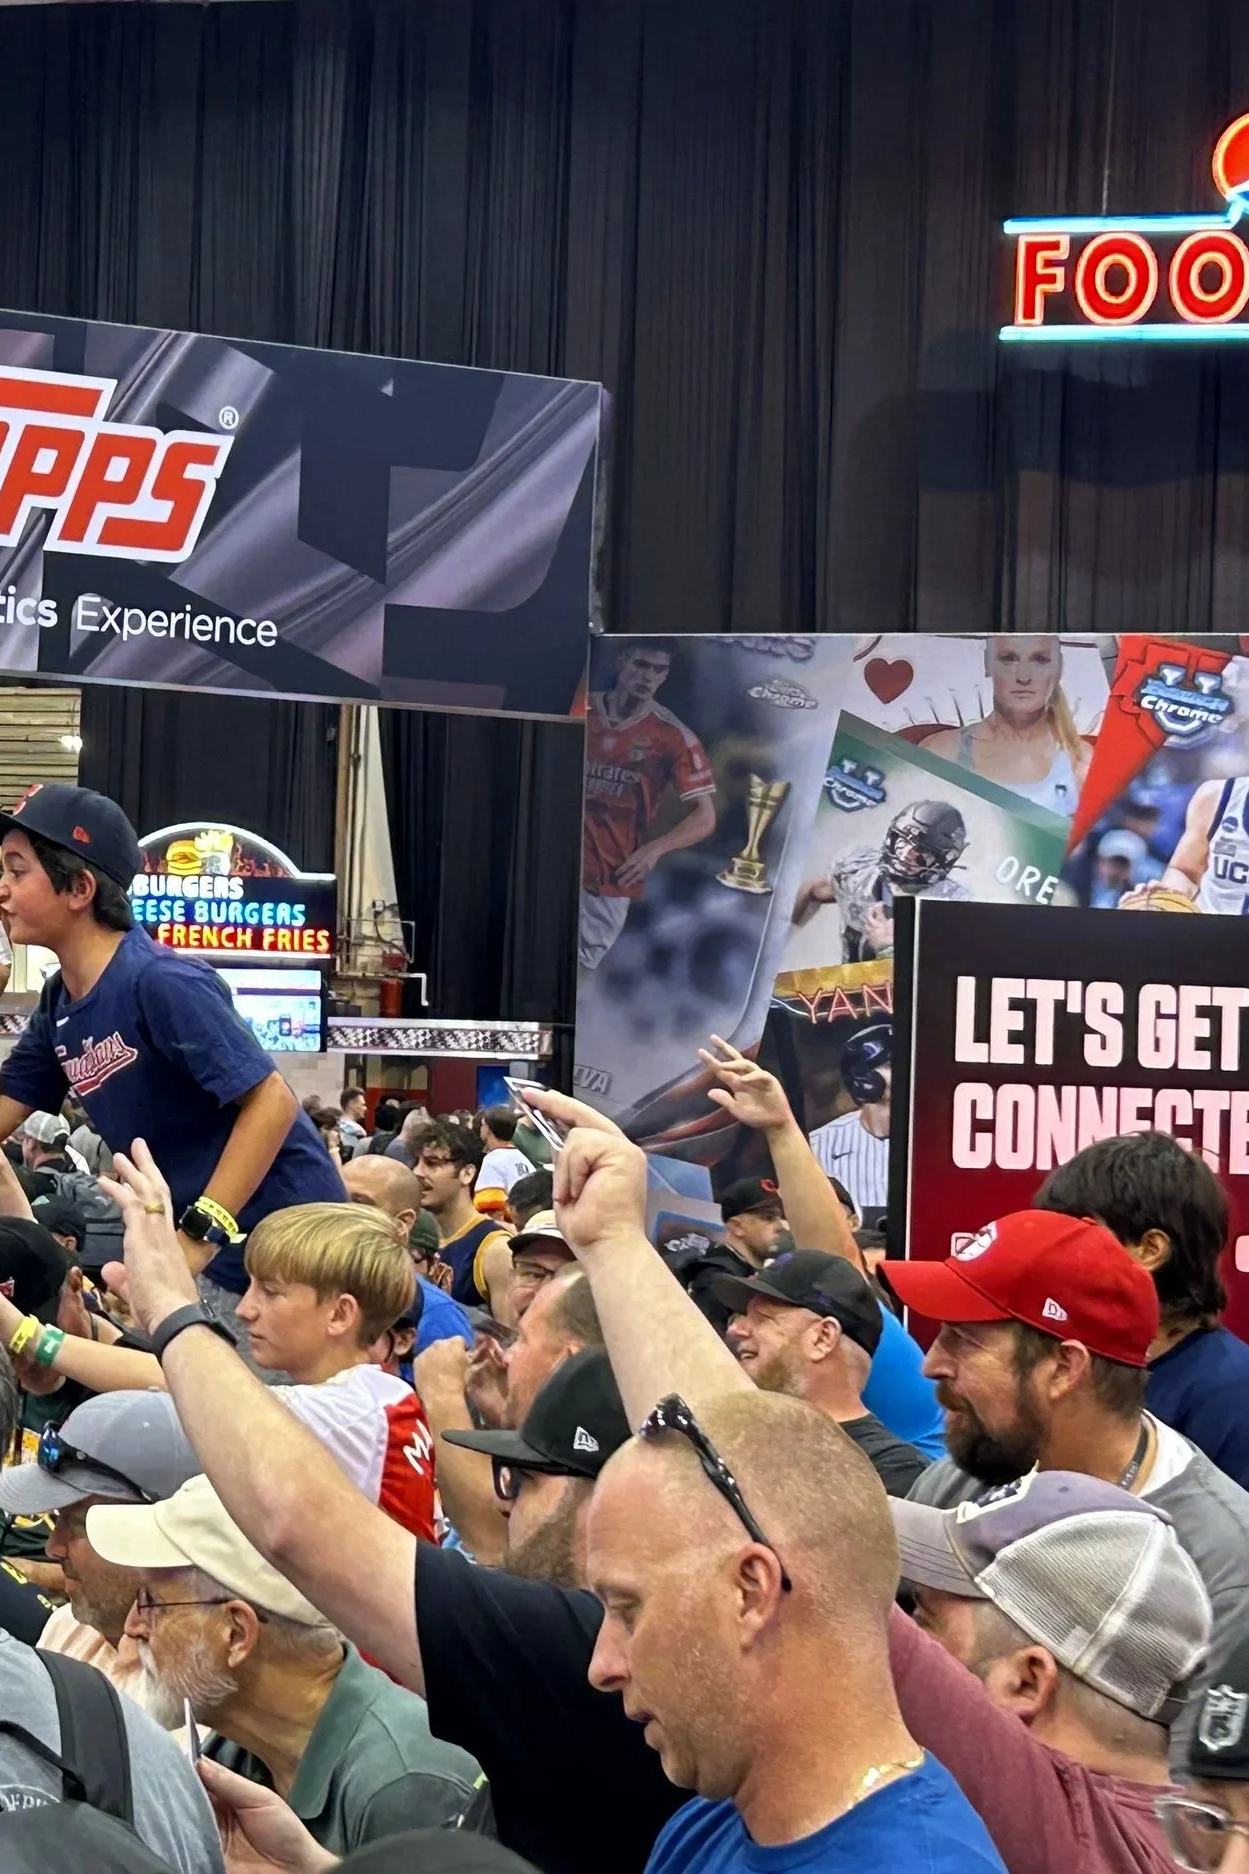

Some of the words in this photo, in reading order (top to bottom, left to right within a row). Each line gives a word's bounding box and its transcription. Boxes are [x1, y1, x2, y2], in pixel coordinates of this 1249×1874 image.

[1015, 231, 1249, 326] FOO
[76, 595, 278, 647] Experience
[127, 874, 244, 900] BURGERS
[1214, 856, 1249, 885] UC
[194, 902, 306, 927] BURGERS
[157, 923, 252, 948] FRENCH
[262, 928, 330, 952] FRIES
[797, 980, 893, 1024] YAN
[955, 976, 1123, 1067] LET'S
[1138, 984, 1249, 1071] GET
